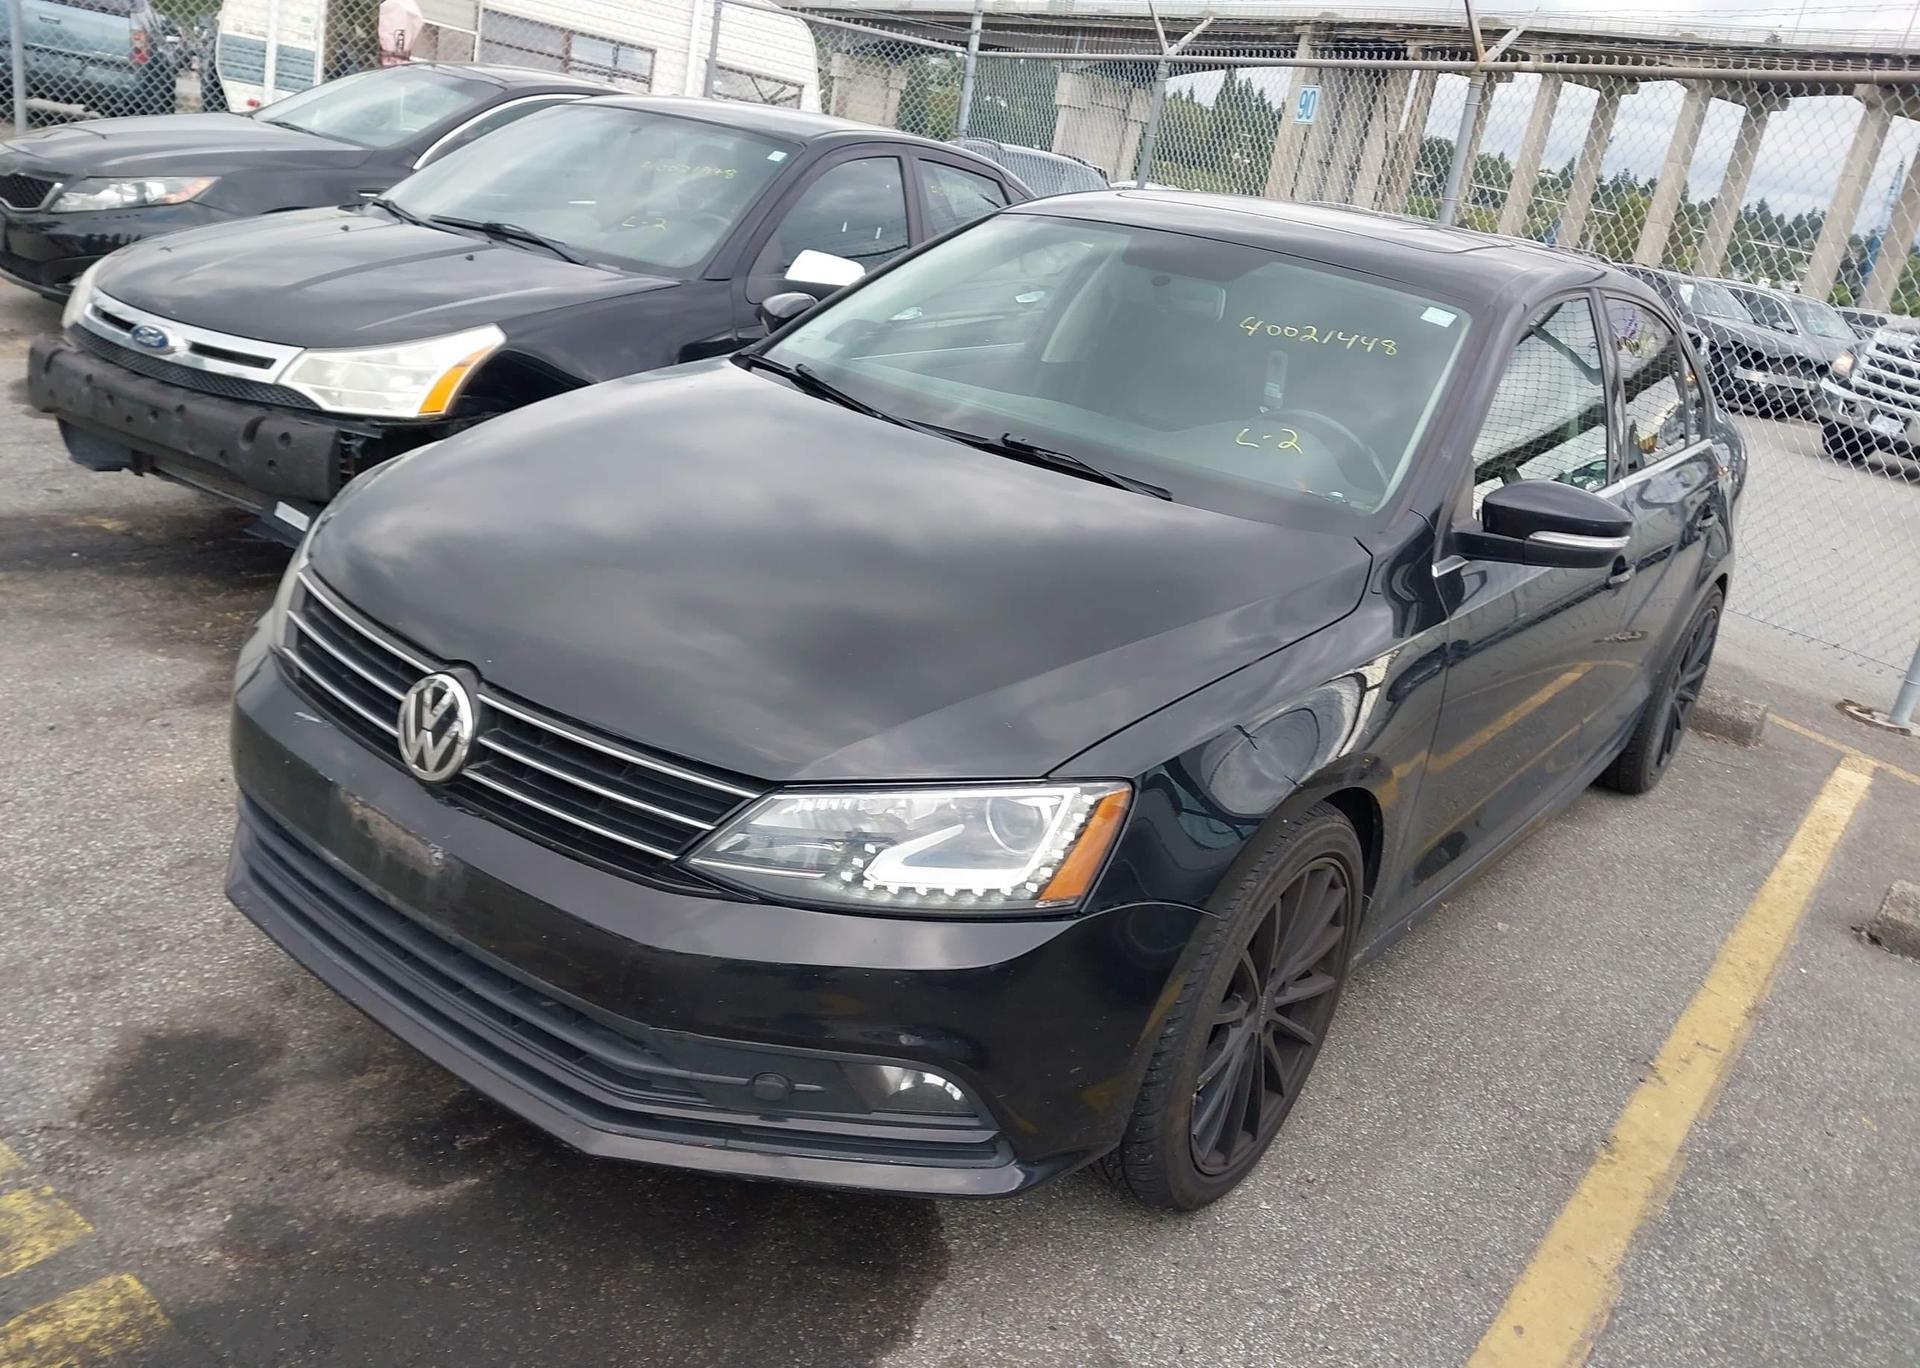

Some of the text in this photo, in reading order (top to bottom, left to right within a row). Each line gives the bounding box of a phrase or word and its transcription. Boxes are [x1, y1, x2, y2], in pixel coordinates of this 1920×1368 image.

[1298, 90, 1316, 119] 90
[1239, 316, 1398, 356] 40021448
[1235, 428, 1303, 454] L-2
